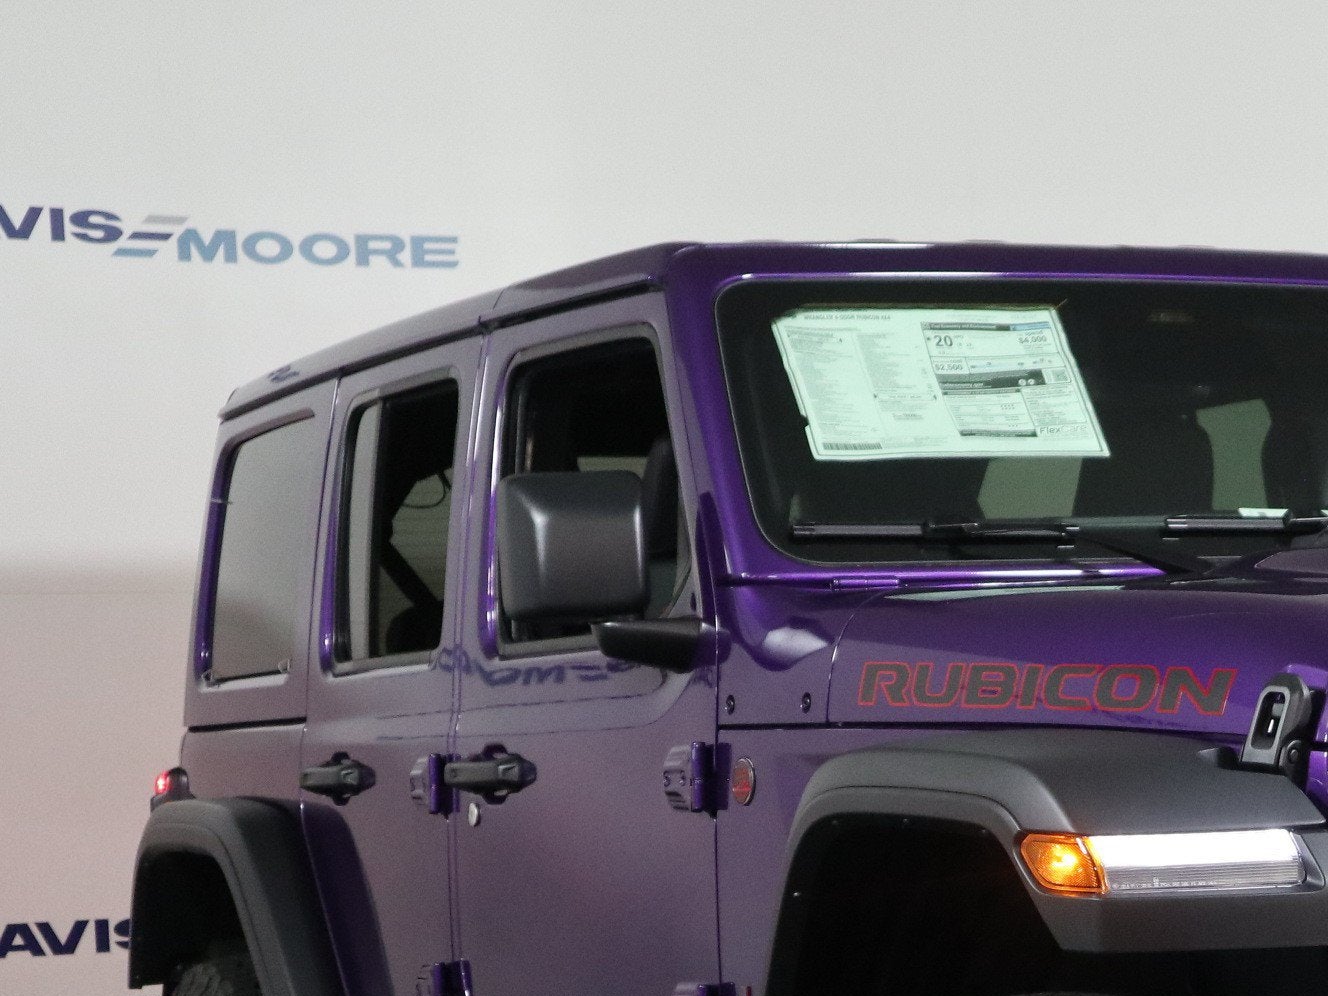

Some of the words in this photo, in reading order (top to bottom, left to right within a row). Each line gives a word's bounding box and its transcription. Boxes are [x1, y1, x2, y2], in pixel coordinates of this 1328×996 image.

[176, 227, 459, 269] MOORE
[933, 334, 954, 347] 20
[857, 661, 1237, 716] RUBICON
